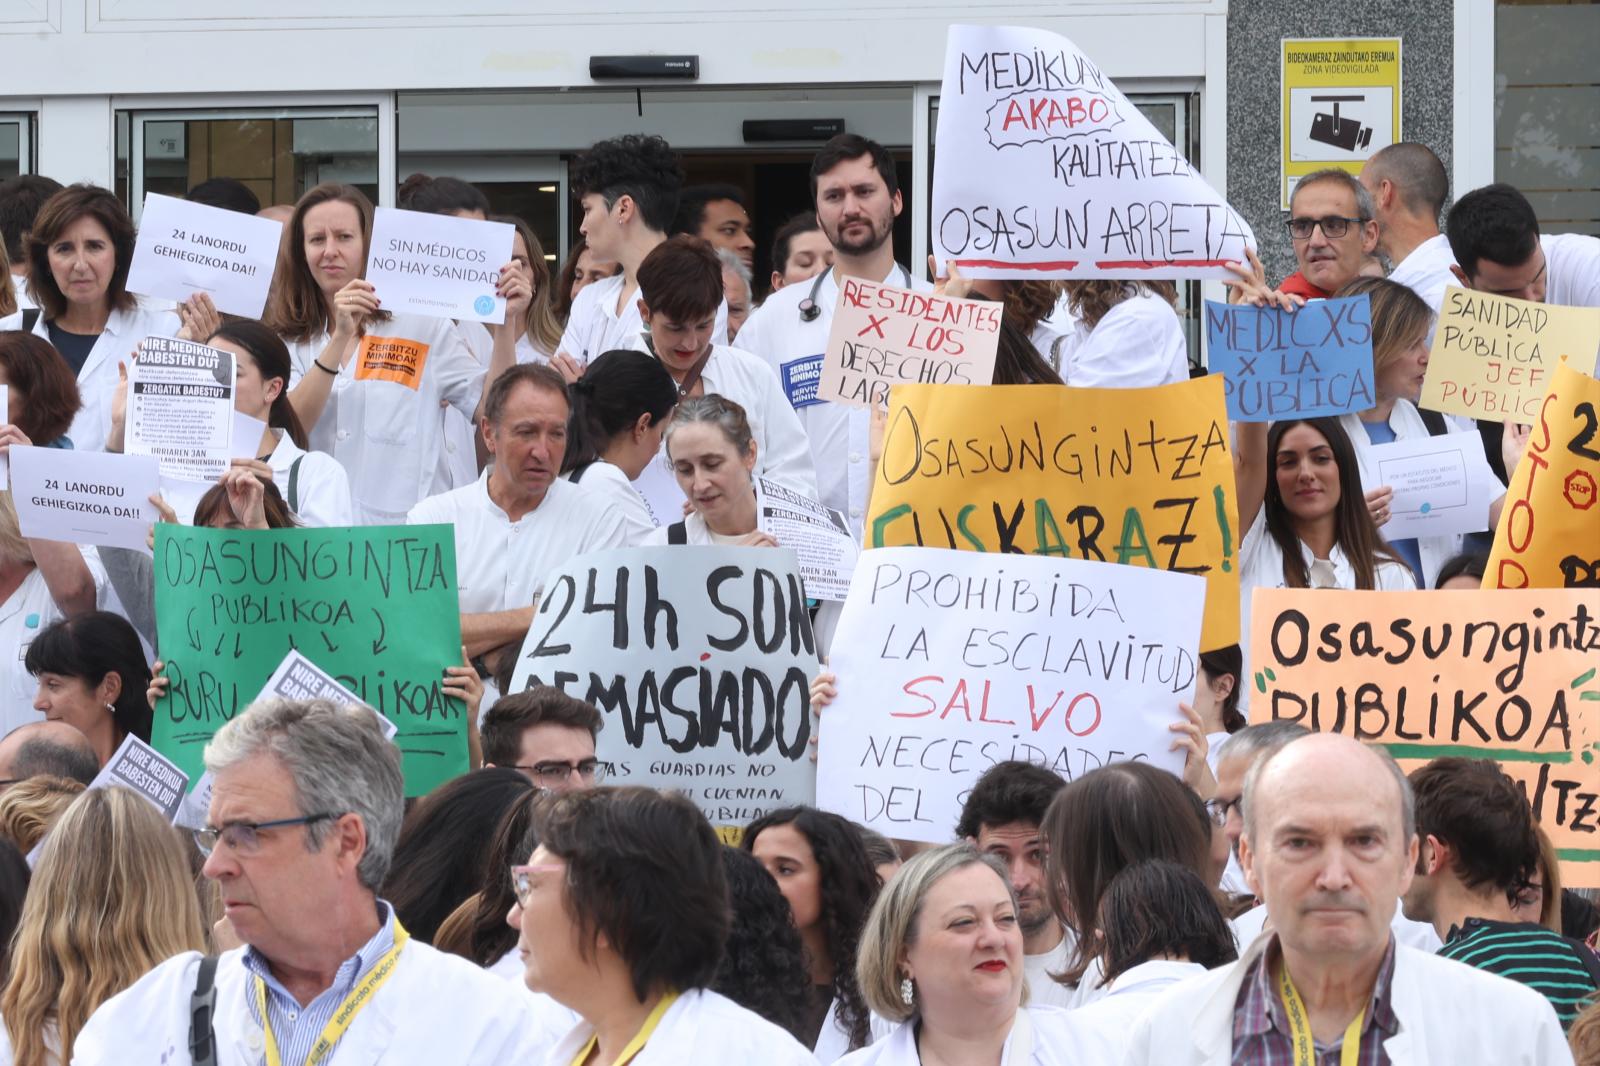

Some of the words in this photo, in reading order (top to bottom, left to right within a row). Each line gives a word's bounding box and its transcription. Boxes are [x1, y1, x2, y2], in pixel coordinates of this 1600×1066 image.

[1287, 52, 1332, 63] BIDEOKAMERAZ
[1333, 51, 1369, 62] ZAINDUTAKO
[1370, 51, 1395, 62] EREMUA
[1303, 65, 1322, 75] ZONA
[1324, 64, 1379, 74] VIDEOVIGILADA
[1003, 97, 1109, 136] AKABO
[171, 229, 186, 241] 24
[191, 233, 247, 254] LANORDU
[940, 200, 1091, 257] OSASUN
[1100, 201, 1249, 266] ARRETA
[153, 245, 229, 271] GEHIEGIZKOA
[231, 262, 257, 277] DA!!
[388, 239, 414, 253] SIN
[417, 241, 486, 263] MÉDICOS
[372, 257, 397, 271] NO
[399, 260, 431, 275] HAY
[432, 264, 500, 285] SANIDAD
[843, 280, 1001, 333] RESIDENTES
[1447, 292, 1548, 335] SANIDAD
[141, 339, 168, 351] NIRE
[169, 341, 219, 358] MEDIKUA
[368, 342, 418, 356] ZERBITZU
[857, 314, 889, 339] X
[907, 323, 965, 355] LOS
[1443, 326, 1543, 364] PÚBLICA
[139, 351, 195, 366] BABESTEN
[197, 357, 220, 369] DUT
[366, 351, 417, 367] MINIMOAK
[840, 340, 973, 385] DERECHOS
[1237, 356, 1258, 377] X
[1280, 351, 1320, 375] LA
[142, 384, 182, 395] ZERGATIK
[183, 385, 224, 397] BABESTU?
[790, 370, 820, 385] MINIMO
[1486, 362, 1545, 388] JEF
[791, 385, 819, 398] SERVIC
[1440, 380, 1542, 417] PÚBLIC
[44, 479, 59, 490] 24
[65, 482, 125, 497] LANORDU
[1569, 482, 1591, 495] STOP
[31, 496, 111, 516] GEHIEGIZKOA
[114, 507, 140, 519] DA!!
[164, 532, 448, 599] OSASUNGINTZA
[871, 563, 1125, 623] PROHIBIDA
[527, 564, 679, 658] 24h
[880, 623, 930, 662] LA
[962, 628, 1195, 694] ESCLAVITUD
[167, 660, 238, 723] BURU
[290, 663, 323, 693] NIRE
[889, 675, 1102, 737] SALVO
[116, 759, 162, 797] BABESTEN
[158, 787, 177, 808] DUT
[126, 744, 152, 768] NIRE
[147, 758, 183, 793] MEDIKUA
[649, 760, 736, 777] GUARDIAS
[747, 763, 776, 777] NO
[853, 784, 935, 823] DEL
[336, 986, 370, 1025] sindicato
